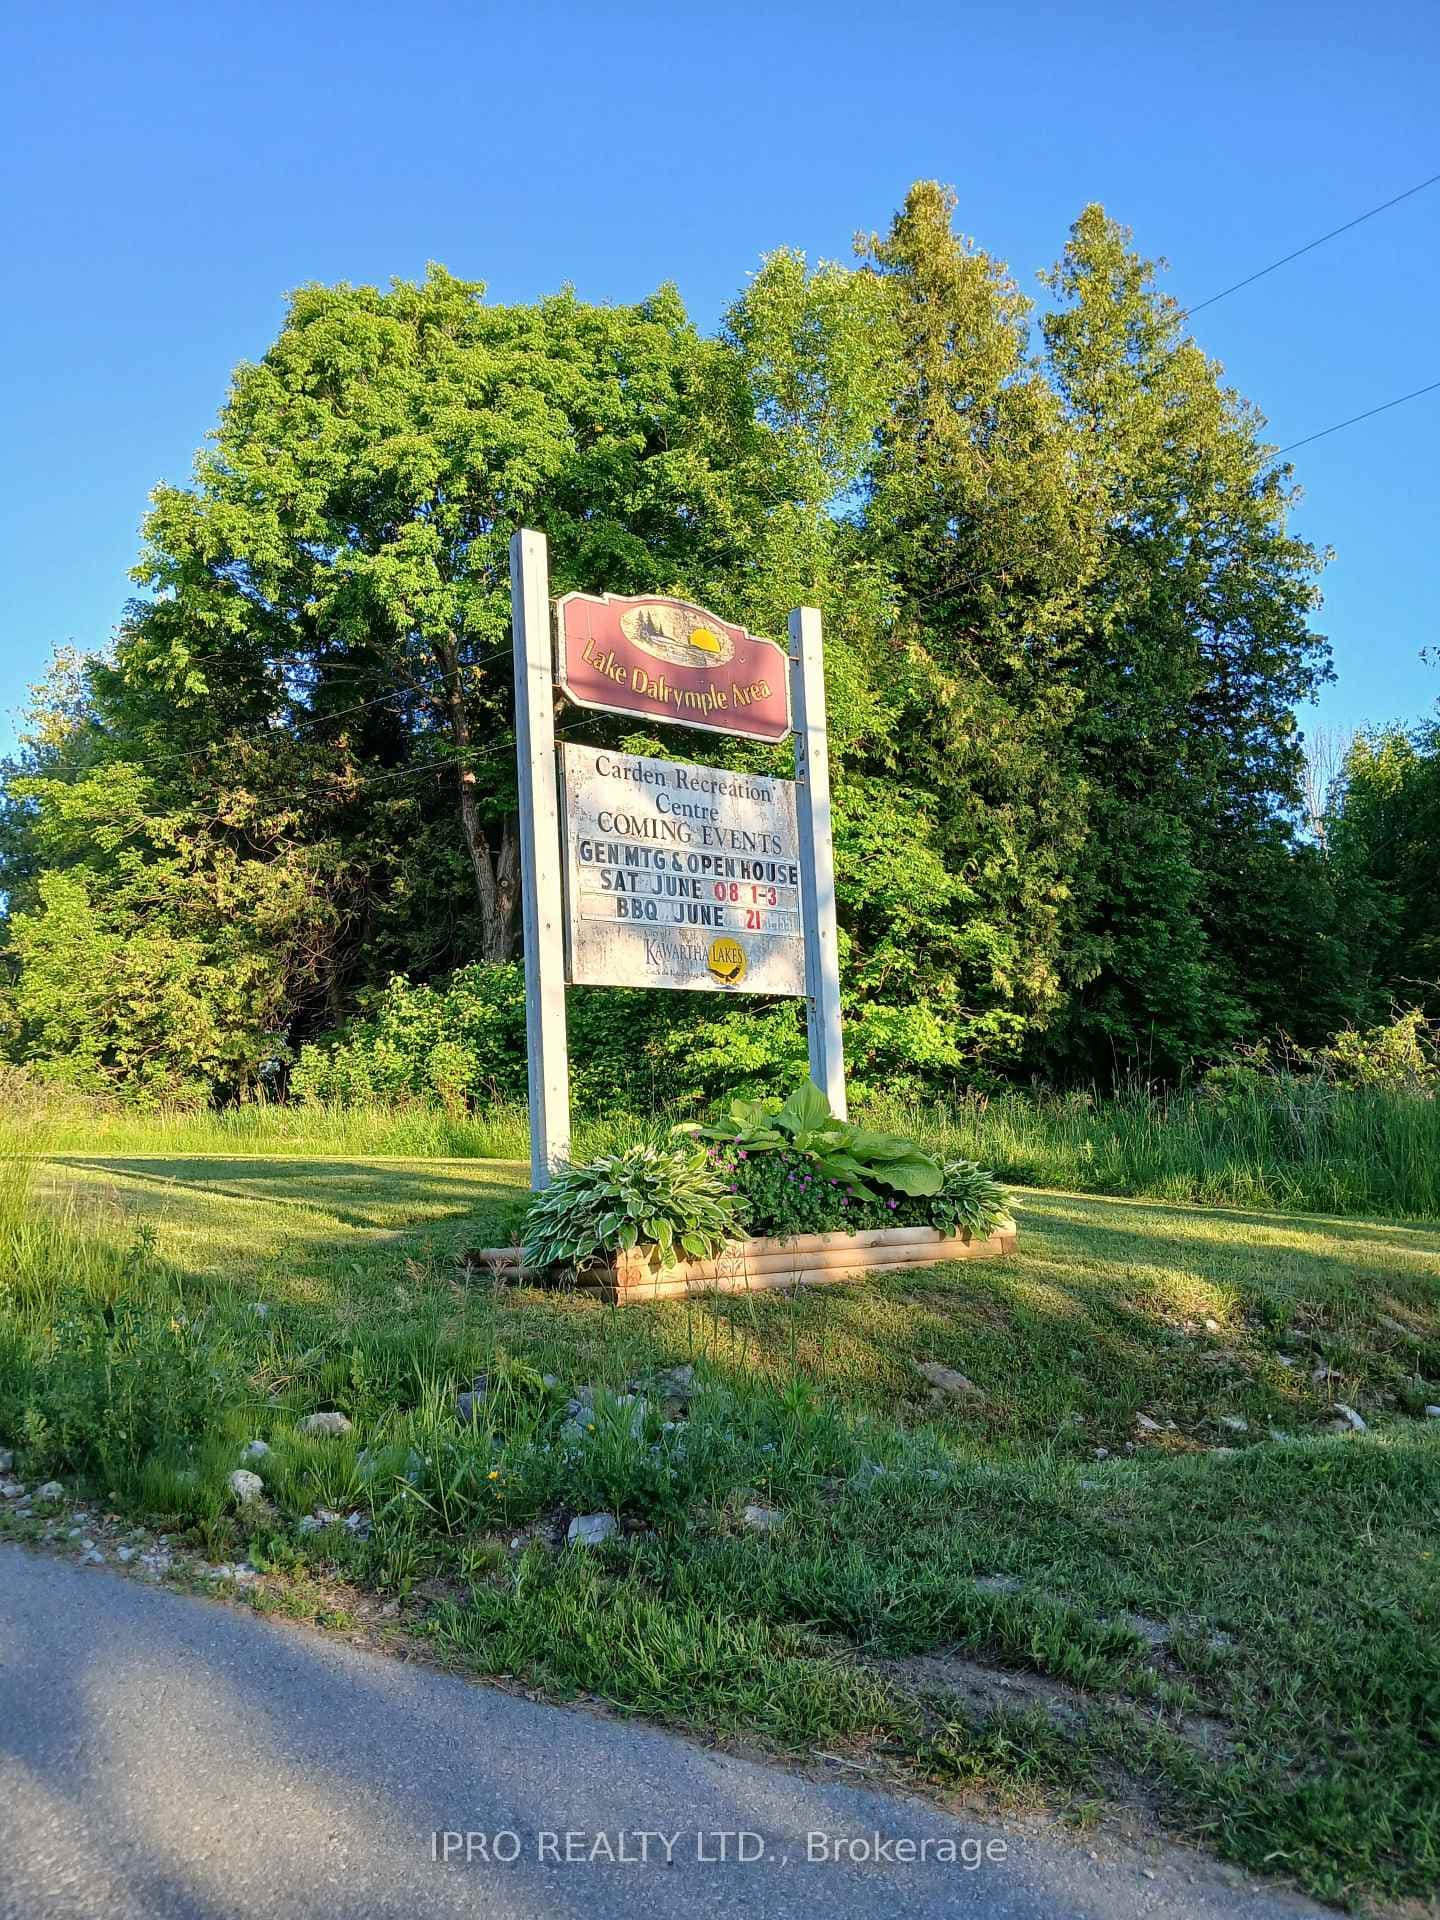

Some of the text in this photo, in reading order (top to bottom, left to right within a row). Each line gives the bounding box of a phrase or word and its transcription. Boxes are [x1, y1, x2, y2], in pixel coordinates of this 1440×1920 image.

[581, 638, 772, 716] Lake Dalrymple Area
[595, 755, 771, 802] Carden Recreation
[655, 792, 720, 822] Centre
[597, 811, 783, 856] COMING EVENTS
[579, 841, 799, 886] GEN MTG & OPEN HOUSE
[600, 869, 777, 906] SAT JUNE 08 1-3
[616, 896, 762, 930] BBQ JUNE 21
[711, 947, 744, 965] LAKES
